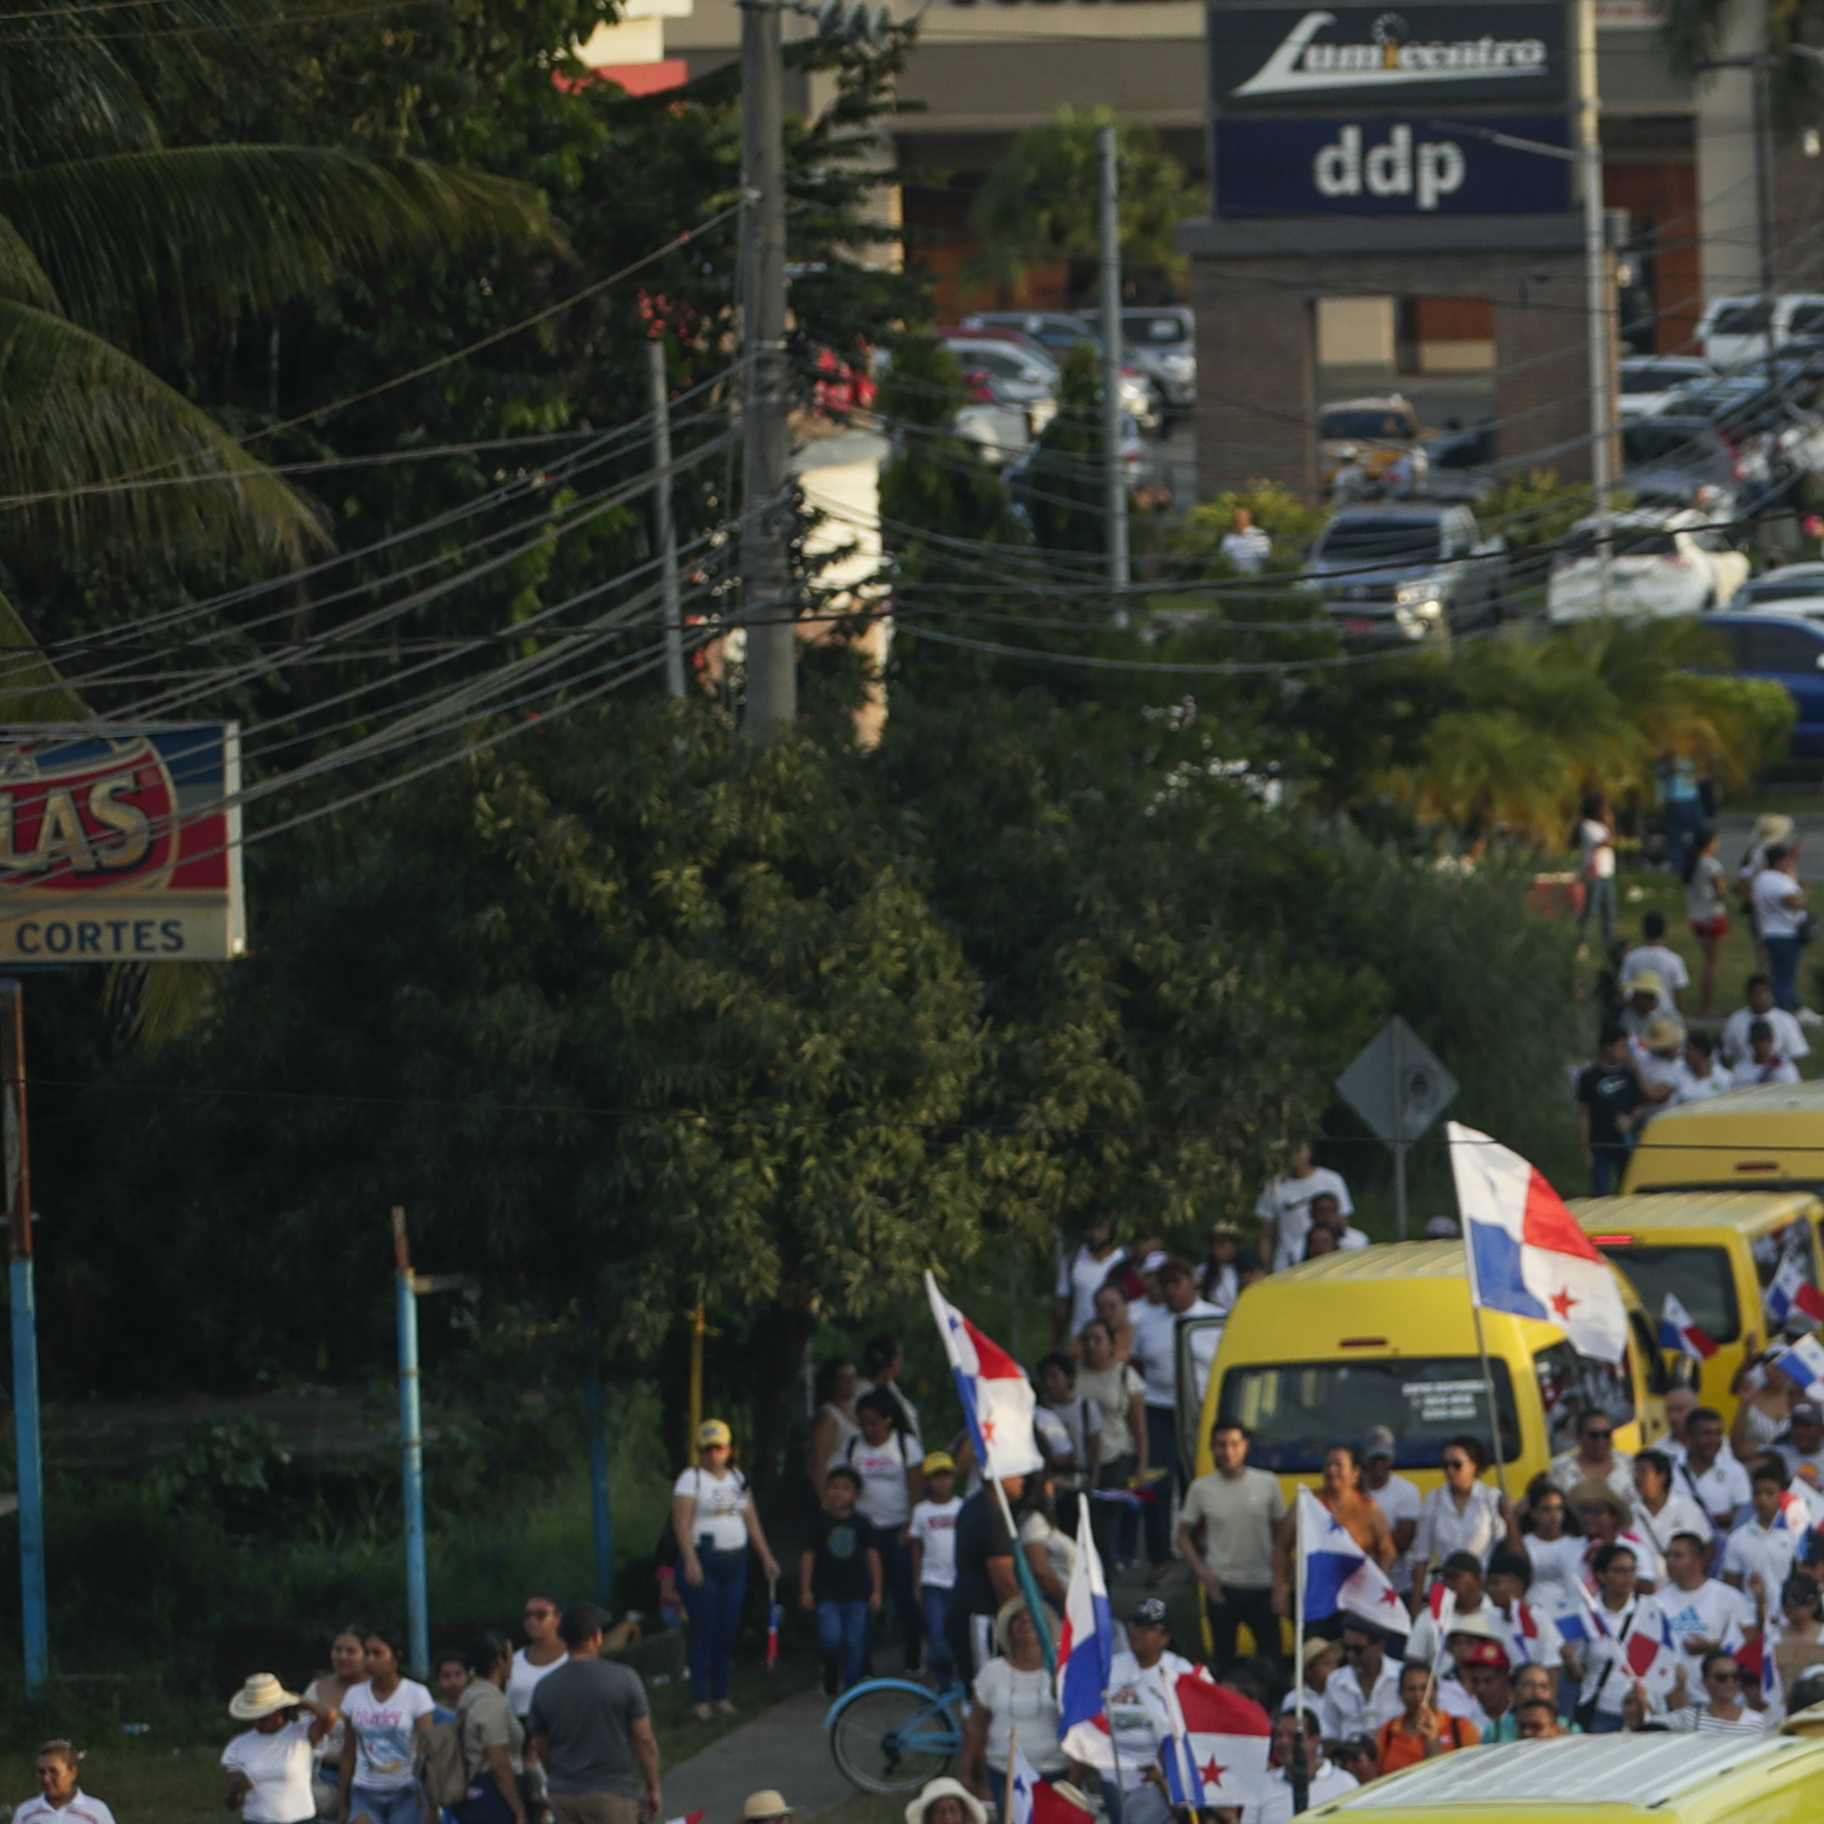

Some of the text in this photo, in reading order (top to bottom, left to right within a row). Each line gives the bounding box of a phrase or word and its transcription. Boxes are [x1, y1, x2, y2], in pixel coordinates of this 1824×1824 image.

[1236, 12, 1547, 97] Lumicentro
[1313, 124, 1466, 209] ddp
[16, 919, 185, 954] CORTES
